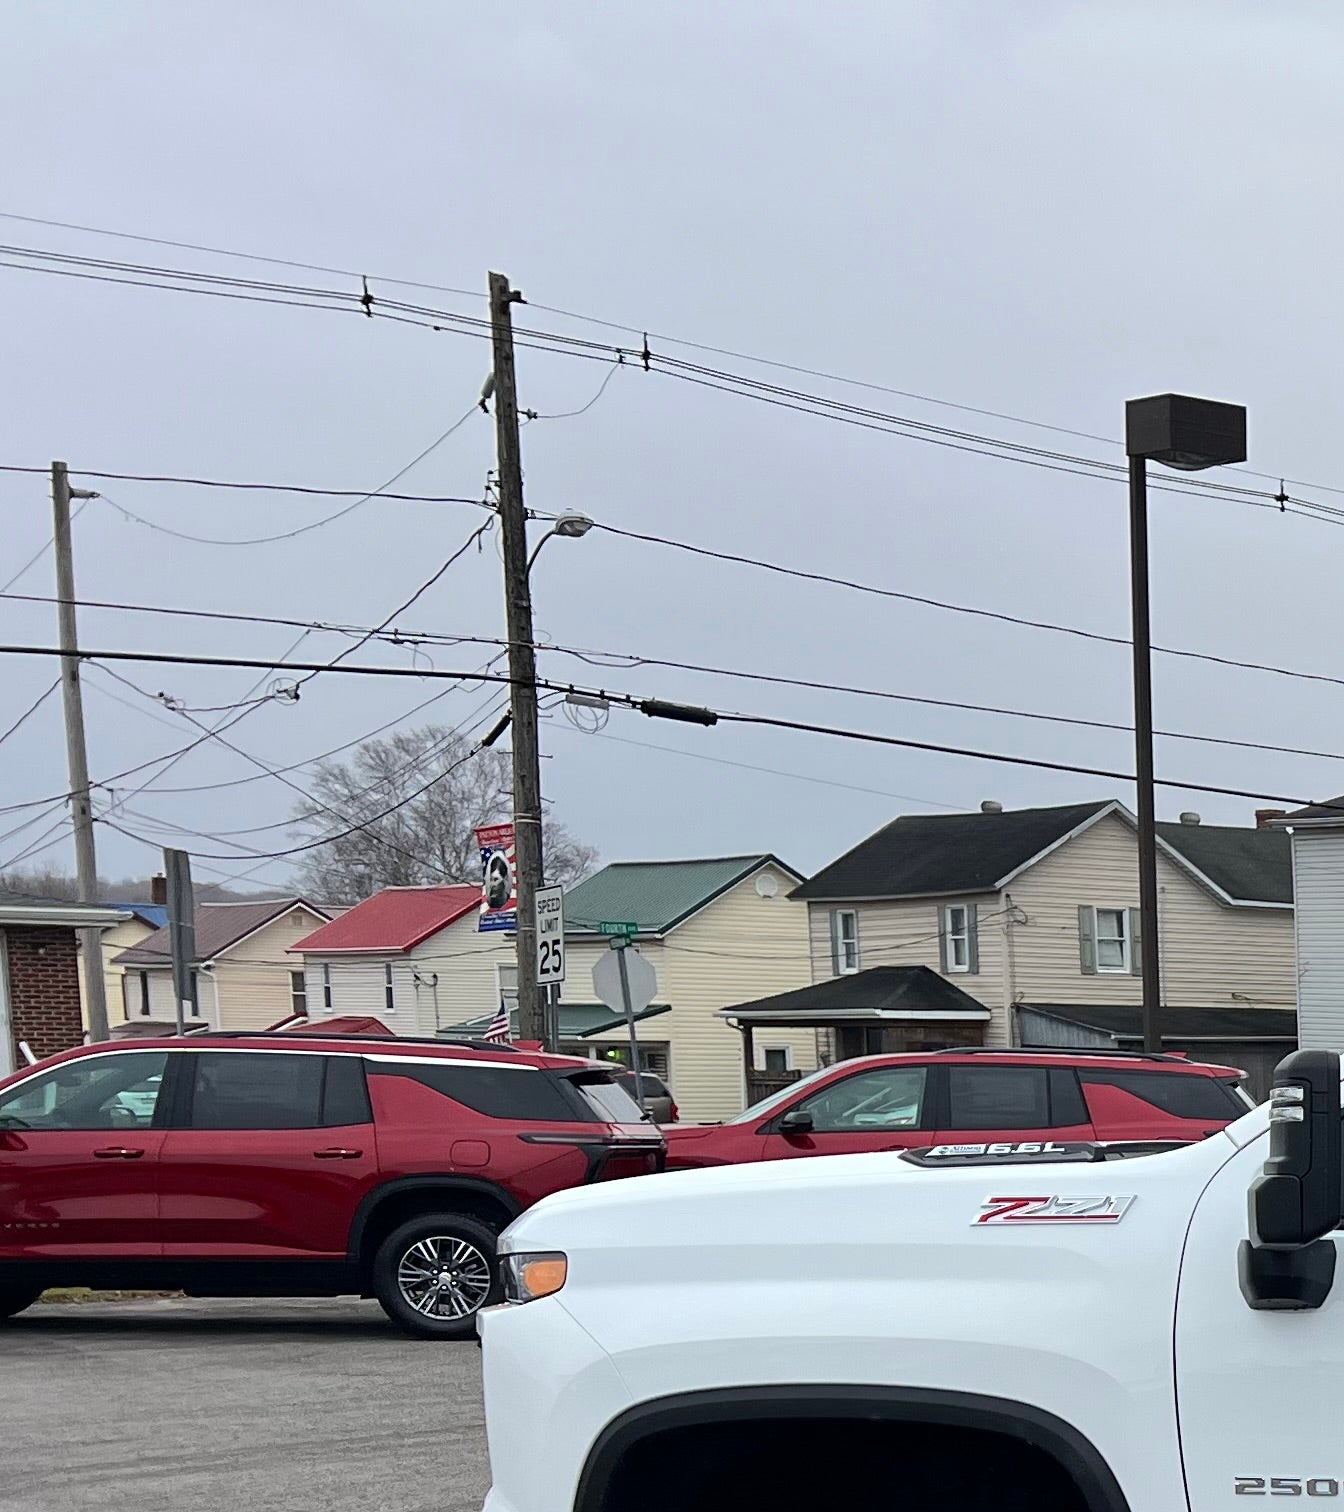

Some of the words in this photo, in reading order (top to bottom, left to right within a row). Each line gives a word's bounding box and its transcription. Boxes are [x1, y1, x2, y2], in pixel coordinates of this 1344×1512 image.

[538, 898, 560, 914] SPEED
[541, 917, 558, 933] LIMIT
[540, 939, 561, 975] 25
[987, 1142, 1065, 1154] 6.6L
[972, 1195, 1136, 1226] Z71
